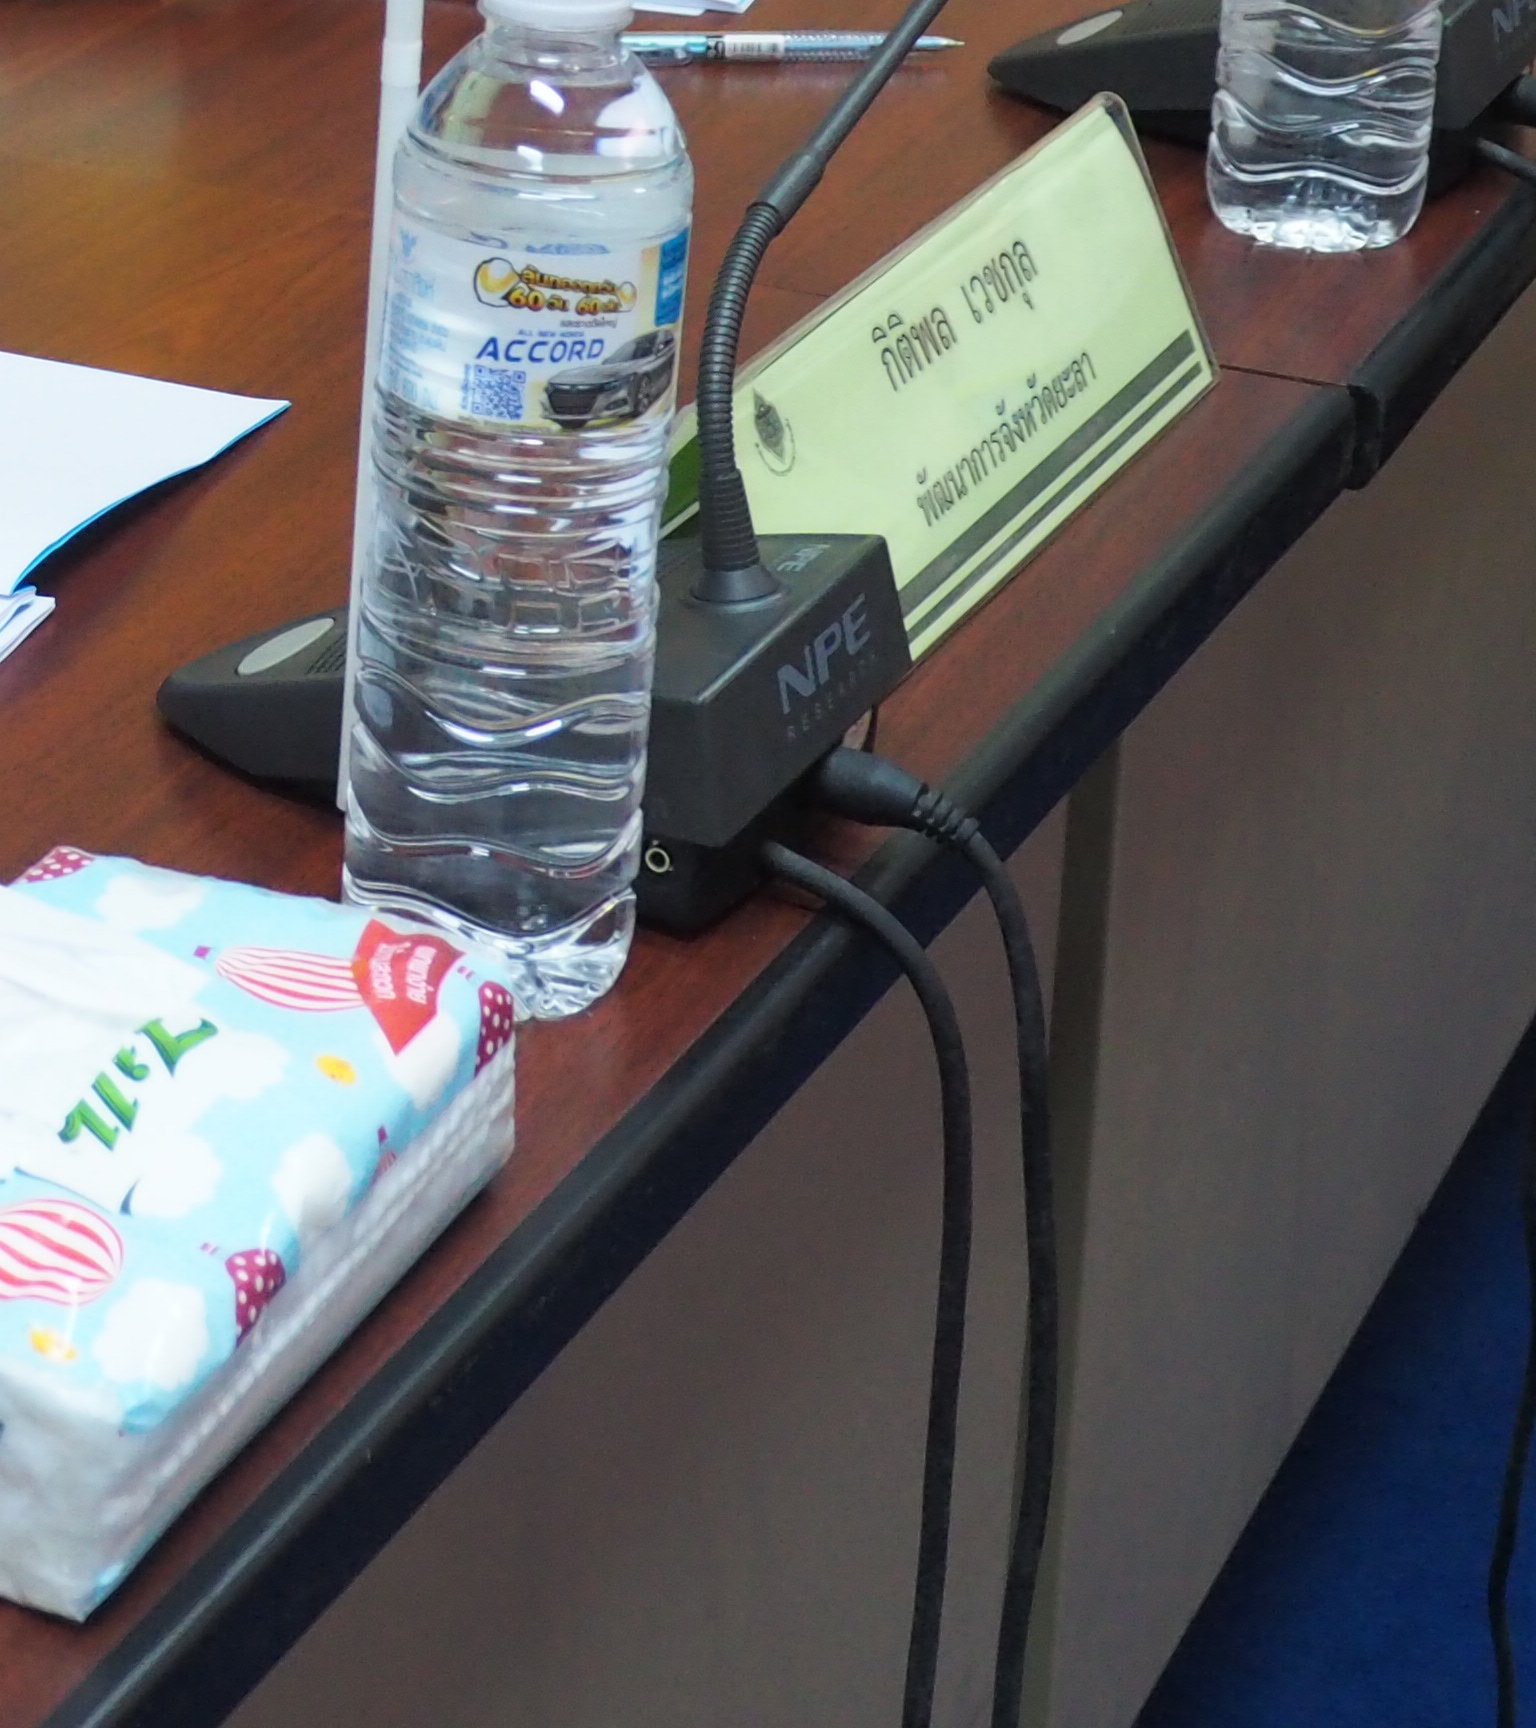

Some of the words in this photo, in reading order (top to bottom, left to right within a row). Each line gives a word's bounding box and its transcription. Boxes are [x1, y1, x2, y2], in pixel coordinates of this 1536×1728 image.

[476, 336, 605, 363] ACCORD
[872, 307, 958, 392] กิติพล
[960, 240, 1039, 324] เวชกุล
[916, 351, 1097, 527] พัฒนาการจังหวัดยะลา
[777, 593, 871, 715] NPE
